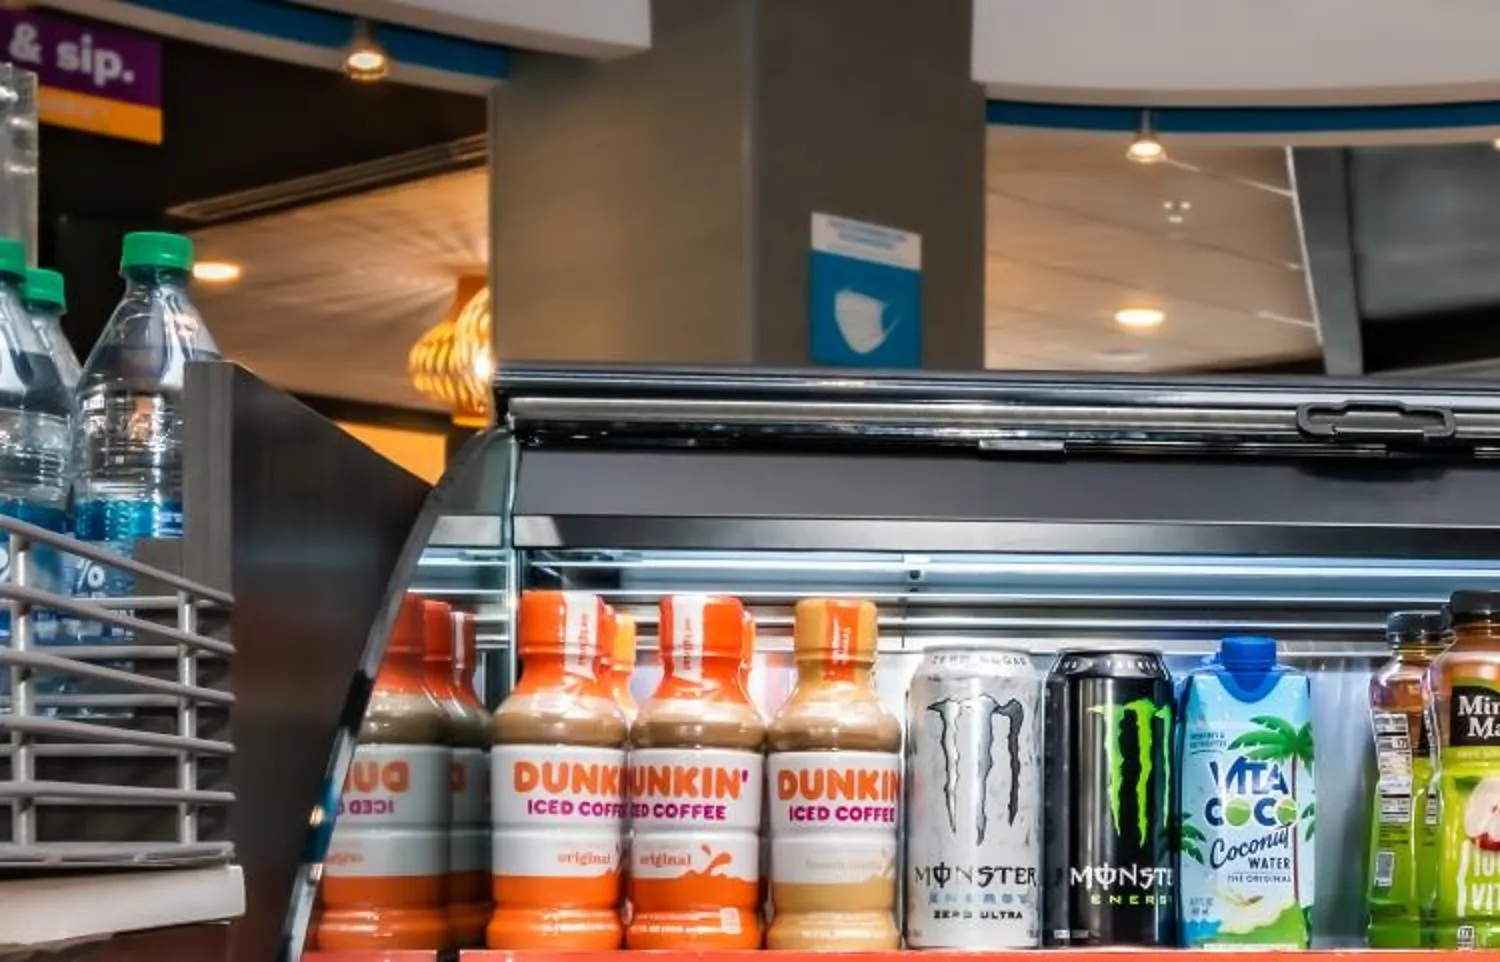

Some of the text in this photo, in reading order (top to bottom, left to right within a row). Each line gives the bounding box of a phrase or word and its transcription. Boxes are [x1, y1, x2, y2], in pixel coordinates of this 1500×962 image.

[8, 22, 135, 85] & sip.
[628, 765, 748, 799] UNKIN'
[1209, 756, 1289, 795] VITA
[527, 800, 573, 815] ICED
[653, 803, 725, 820] COFFEE
[789, 805, 895, 823] ICED COFFEE
[1205, 797, 1297, 826] COCO
[1210, 823, 1290, 870] Coconut
[558, 852, 611, 866] original
[640, 852, 691, 868] original
[1248, 857, 1290, 870] WATER
[914, 861, 1037, 888] MONSTER
[980, 909, 1023, 919] ULTRA
